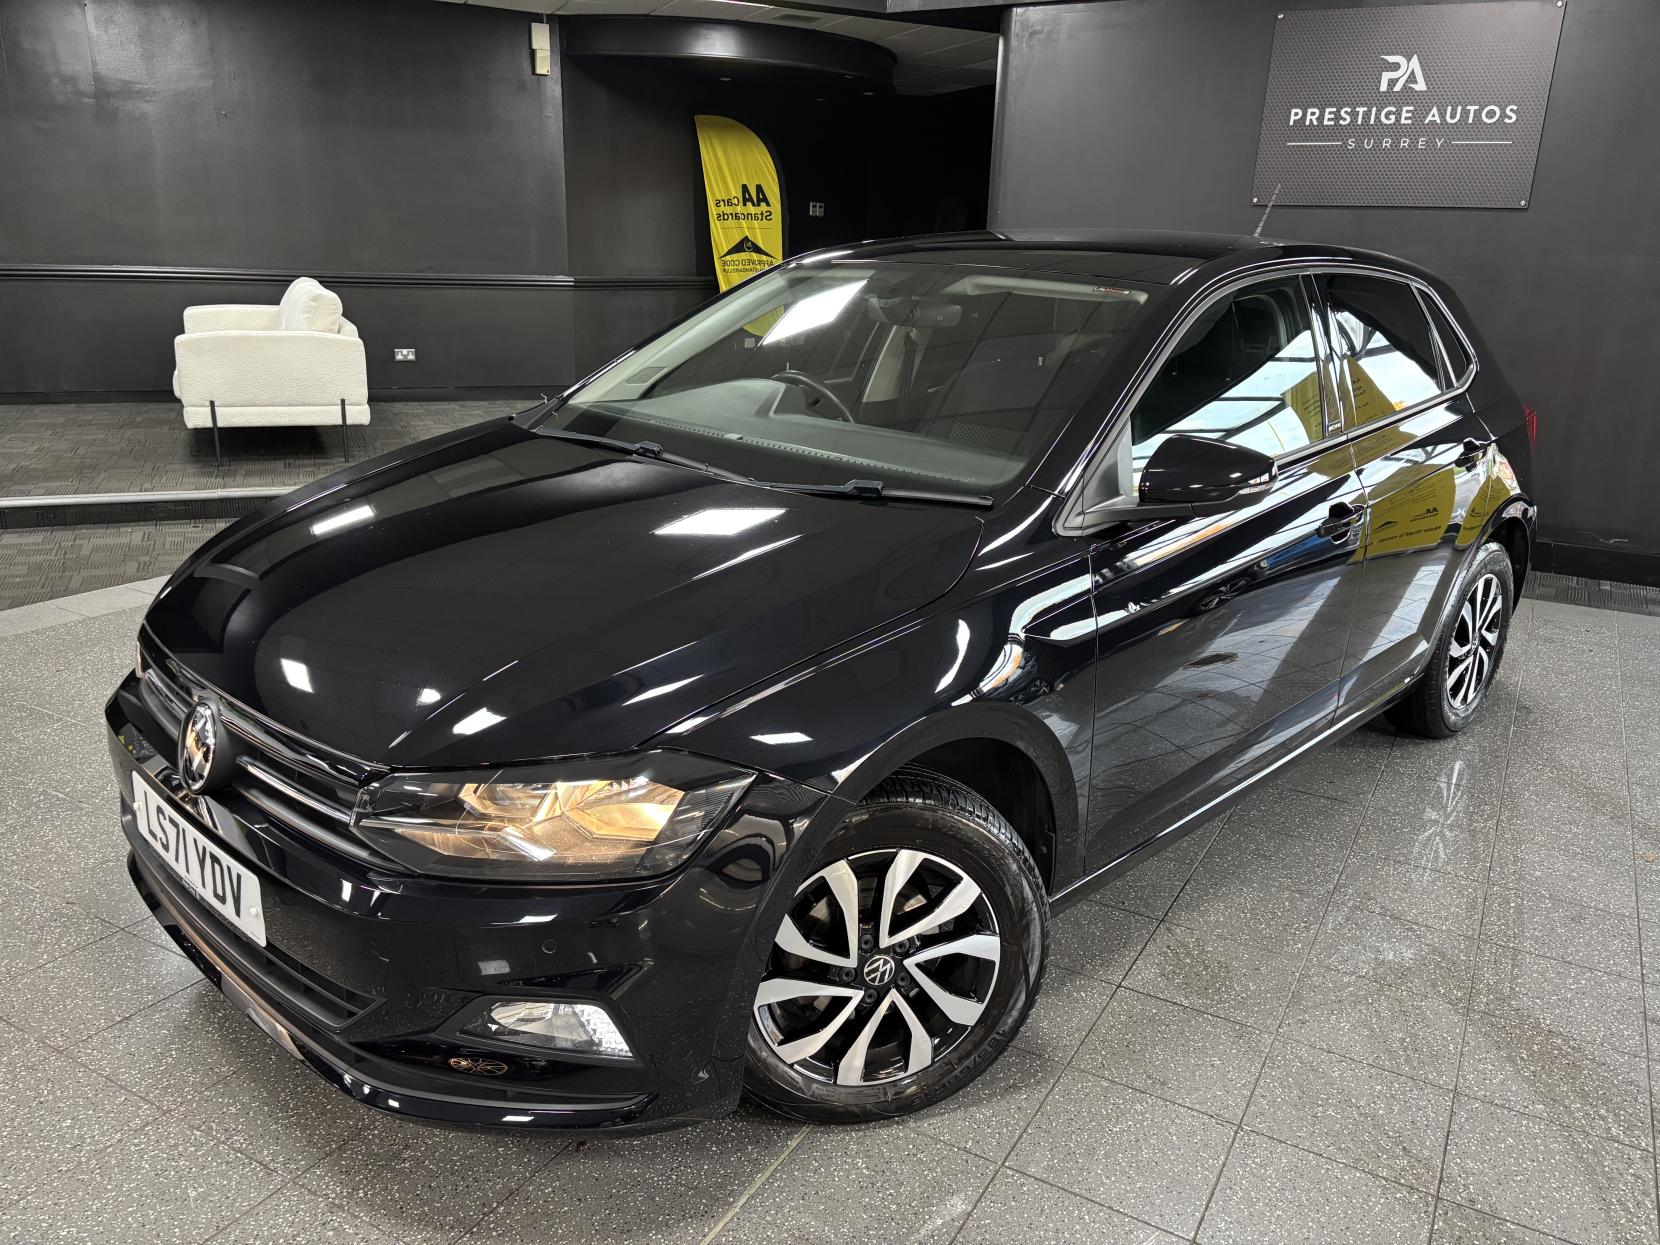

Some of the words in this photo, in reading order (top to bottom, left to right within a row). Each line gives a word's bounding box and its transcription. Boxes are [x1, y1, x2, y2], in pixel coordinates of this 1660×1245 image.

[1379, 54, 1427, 92] PA
[1289, 106, 1415, 126] PRESTIGE
[1424, 104, 1518, 124] AUTOS
[1346, 137, 1445, 149] SURREY
[143, 790, 190, 875] LS71
[193, 837, 242, 919] YDV
